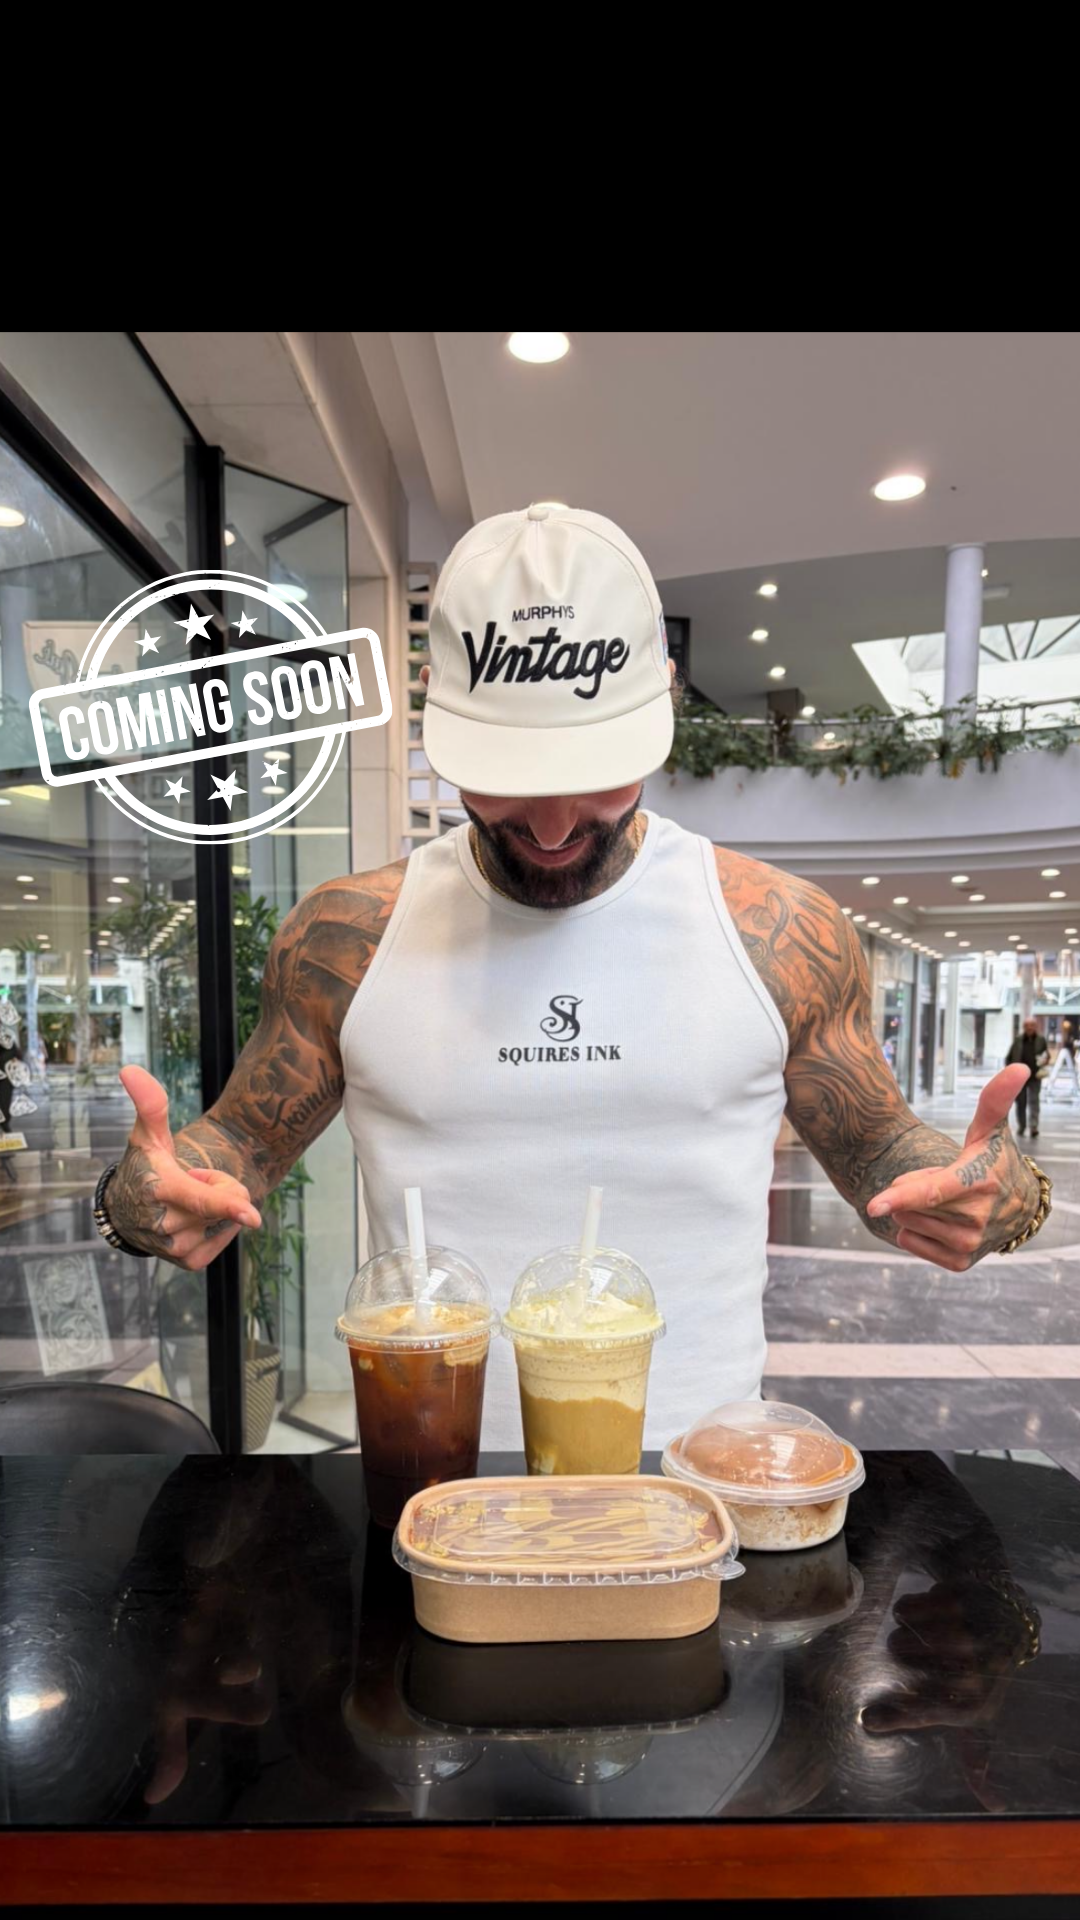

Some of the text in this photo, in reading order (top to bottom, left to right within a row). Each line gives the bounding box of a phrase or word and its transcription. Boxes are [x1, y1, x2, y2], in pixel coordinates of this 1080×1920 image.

[512, 605, 575, 623] MURPHYS
[461, 621, 630, 700] Vintage
[498, 1045, 622, 1067] SQUIRES INK
